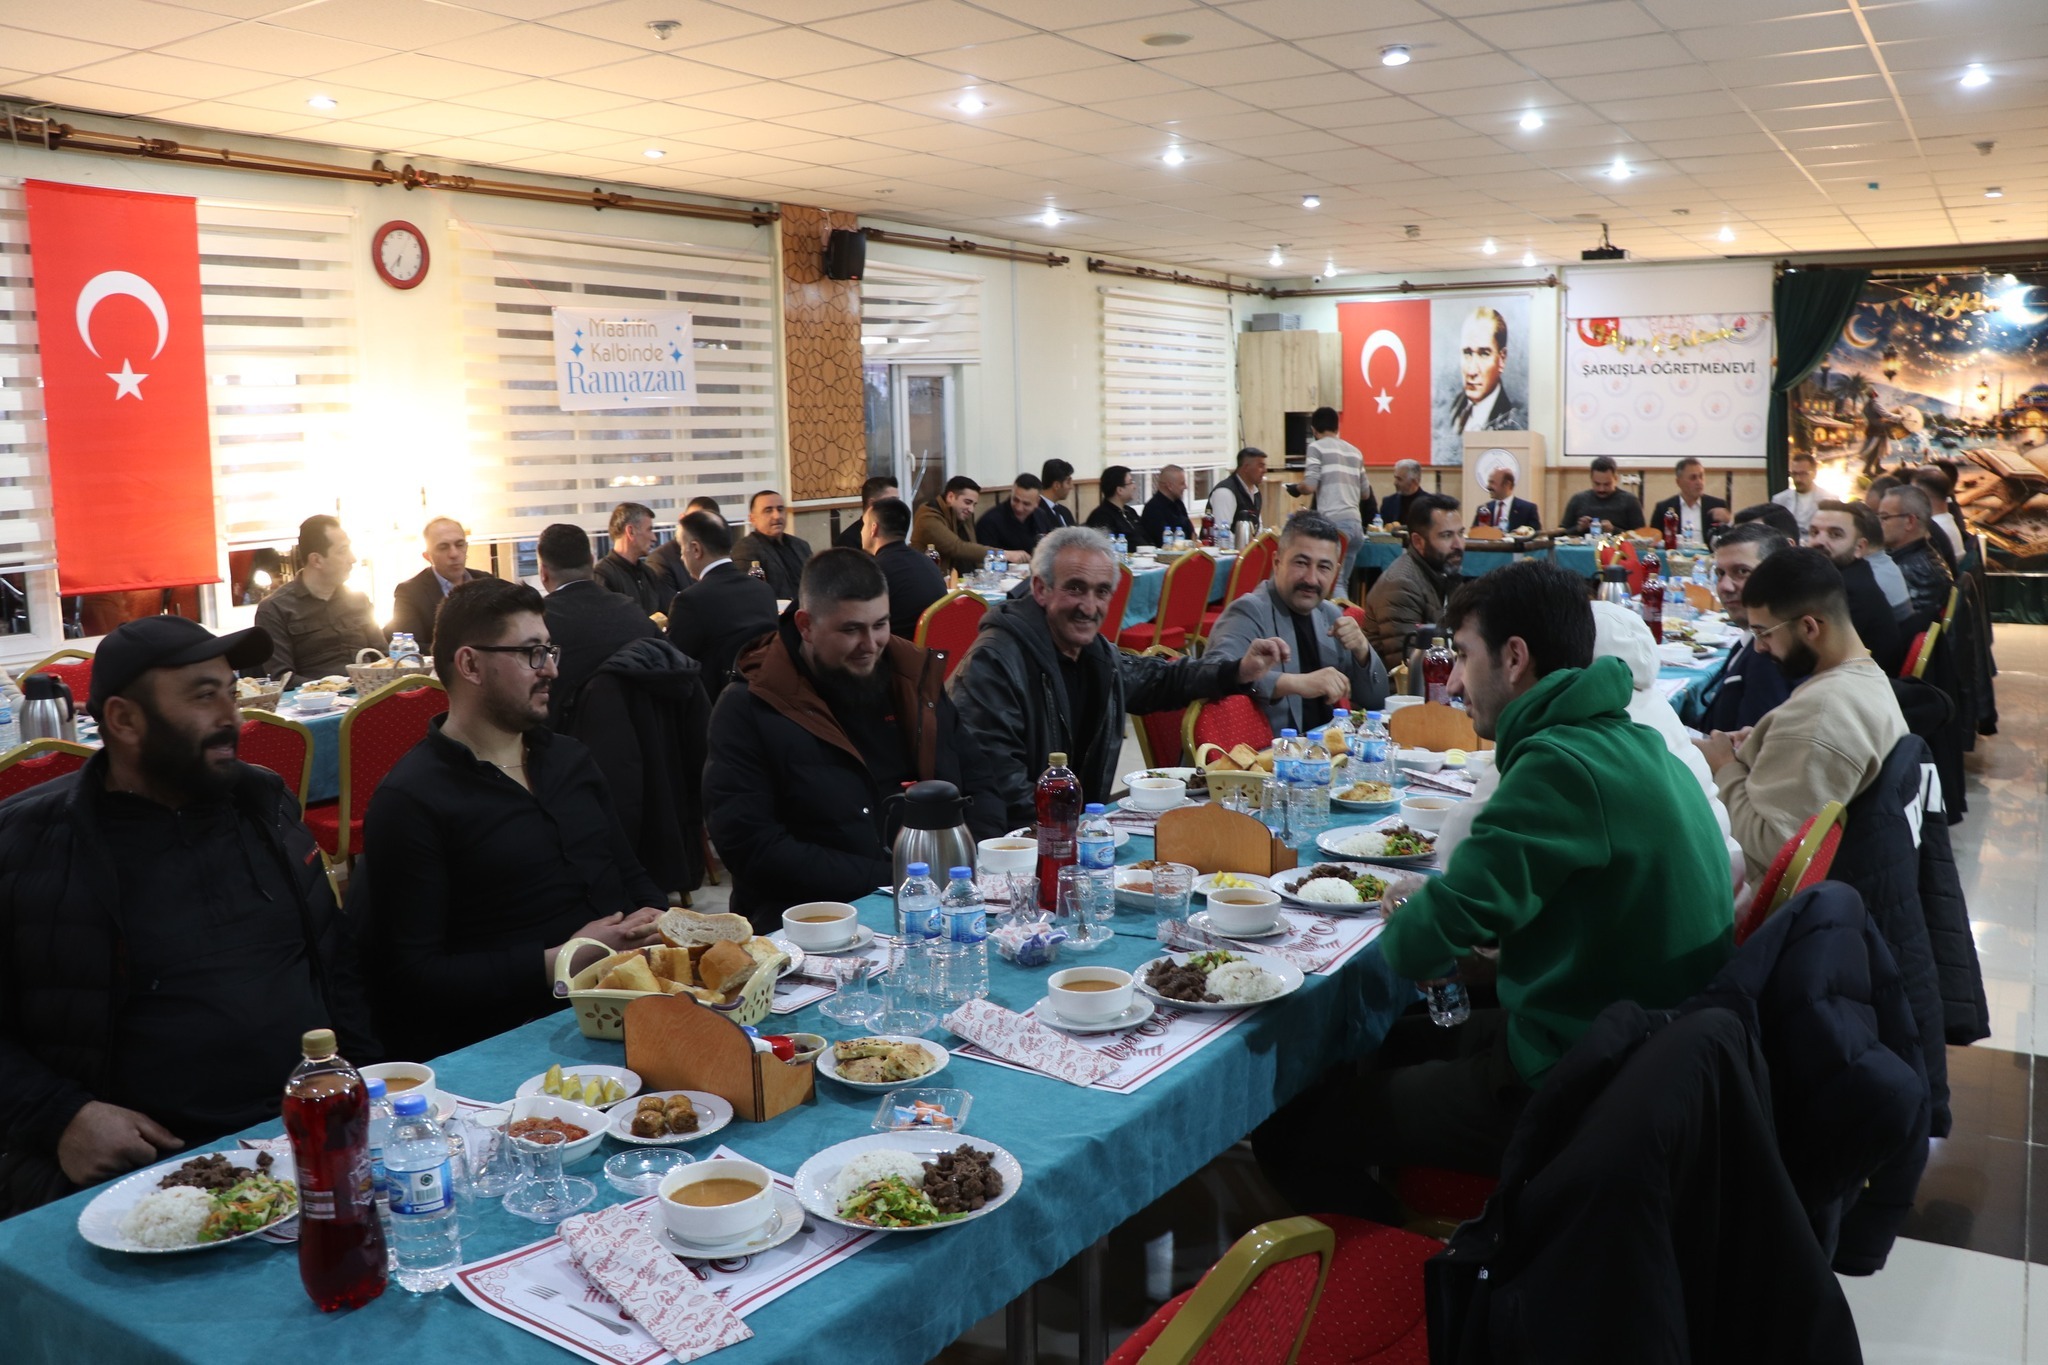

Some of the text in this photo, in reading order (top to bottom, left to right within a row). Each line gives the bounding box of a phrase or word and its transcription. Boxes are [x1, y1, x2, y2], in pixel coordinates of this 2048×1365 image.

[591, 342, 664, 362] Kalbinde
[566, 361, 686, 395] Ramazan
[1581, 362, 1648, 378] ŞARKIŞLA
